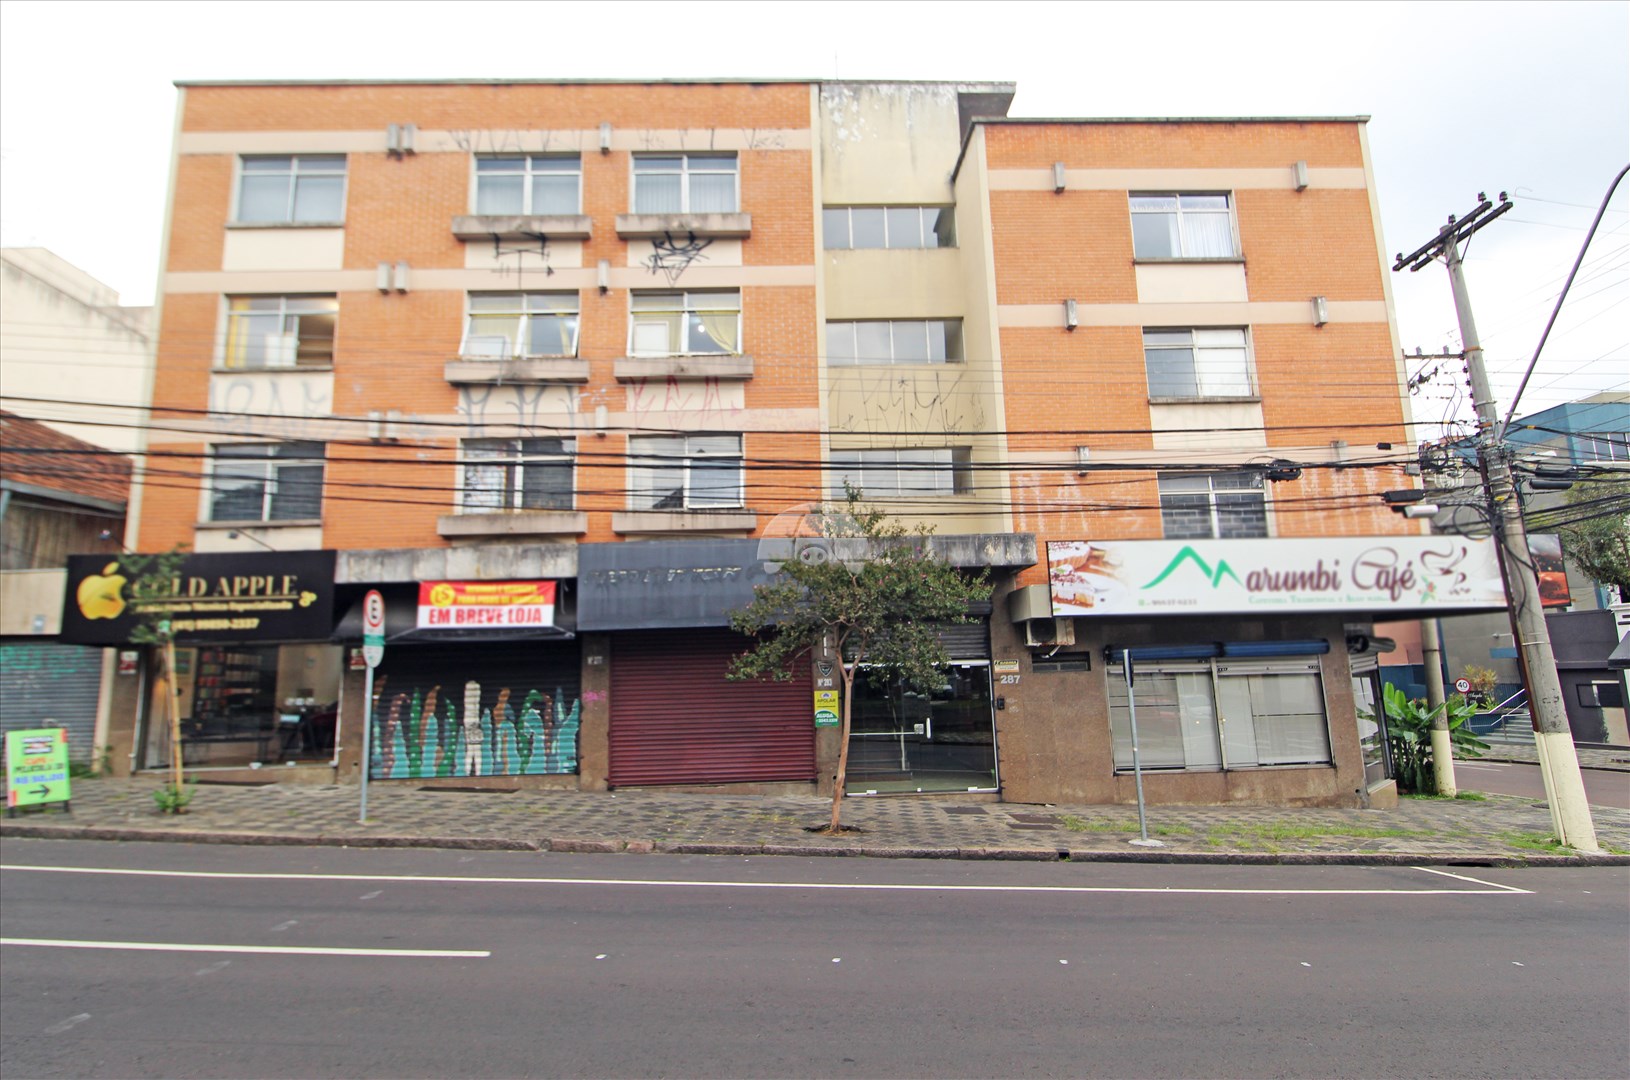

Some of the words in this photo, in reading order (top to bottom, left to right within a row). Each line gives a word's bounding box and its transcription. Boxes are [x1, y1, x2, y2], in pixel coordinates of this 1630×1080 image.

[1352, 546, 1416, 602] Café
[213, 575, 299, 596] APPLE
[429, 608, 451, 624] EM
[455, 608, 504, 624] BREVE
[508, 608, 542, 623] LOJA
[1000, 675, 1020, 684] 287
